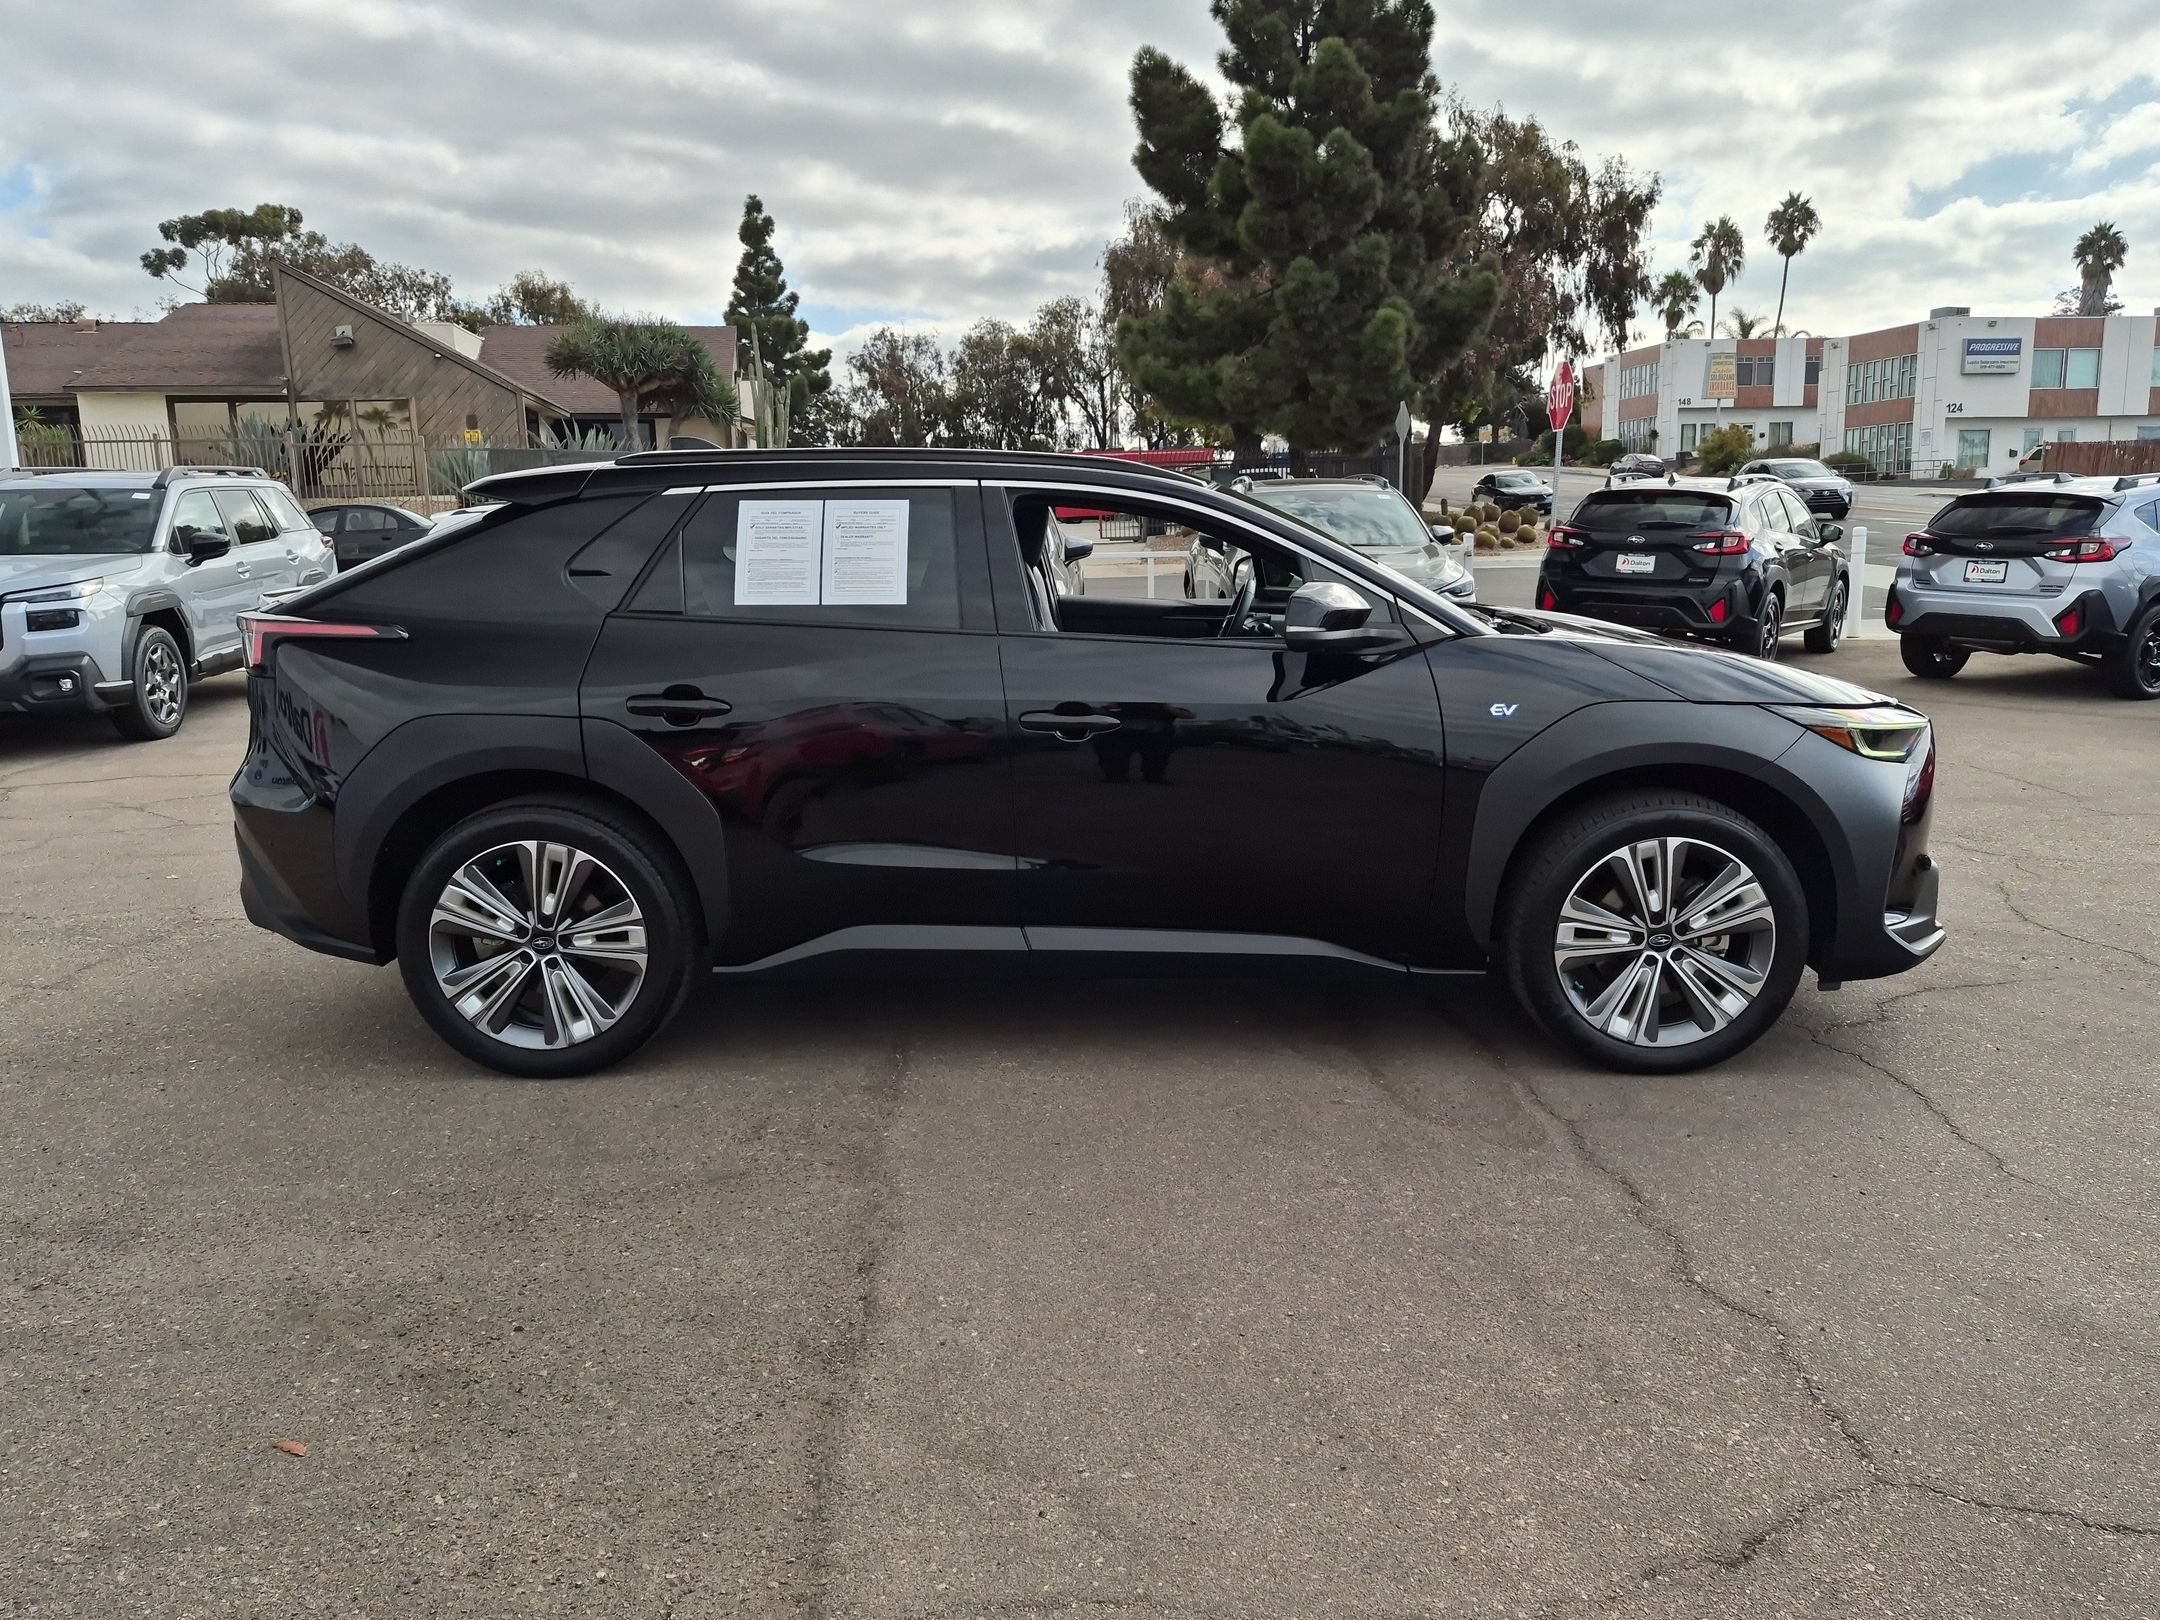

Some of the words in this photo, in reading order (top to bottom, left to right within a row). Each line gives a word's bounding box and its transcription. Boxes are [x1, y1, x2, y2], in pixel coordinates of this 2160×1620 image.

[1969, 343, 2020, 351] PROGRESSIVE
[1550, 382, 1571, 410] STOP
[1678, 398, 1692, 406] 148
[1946, 403, 1963, 413] 124
[1490, 704, 1519, 715] EV
